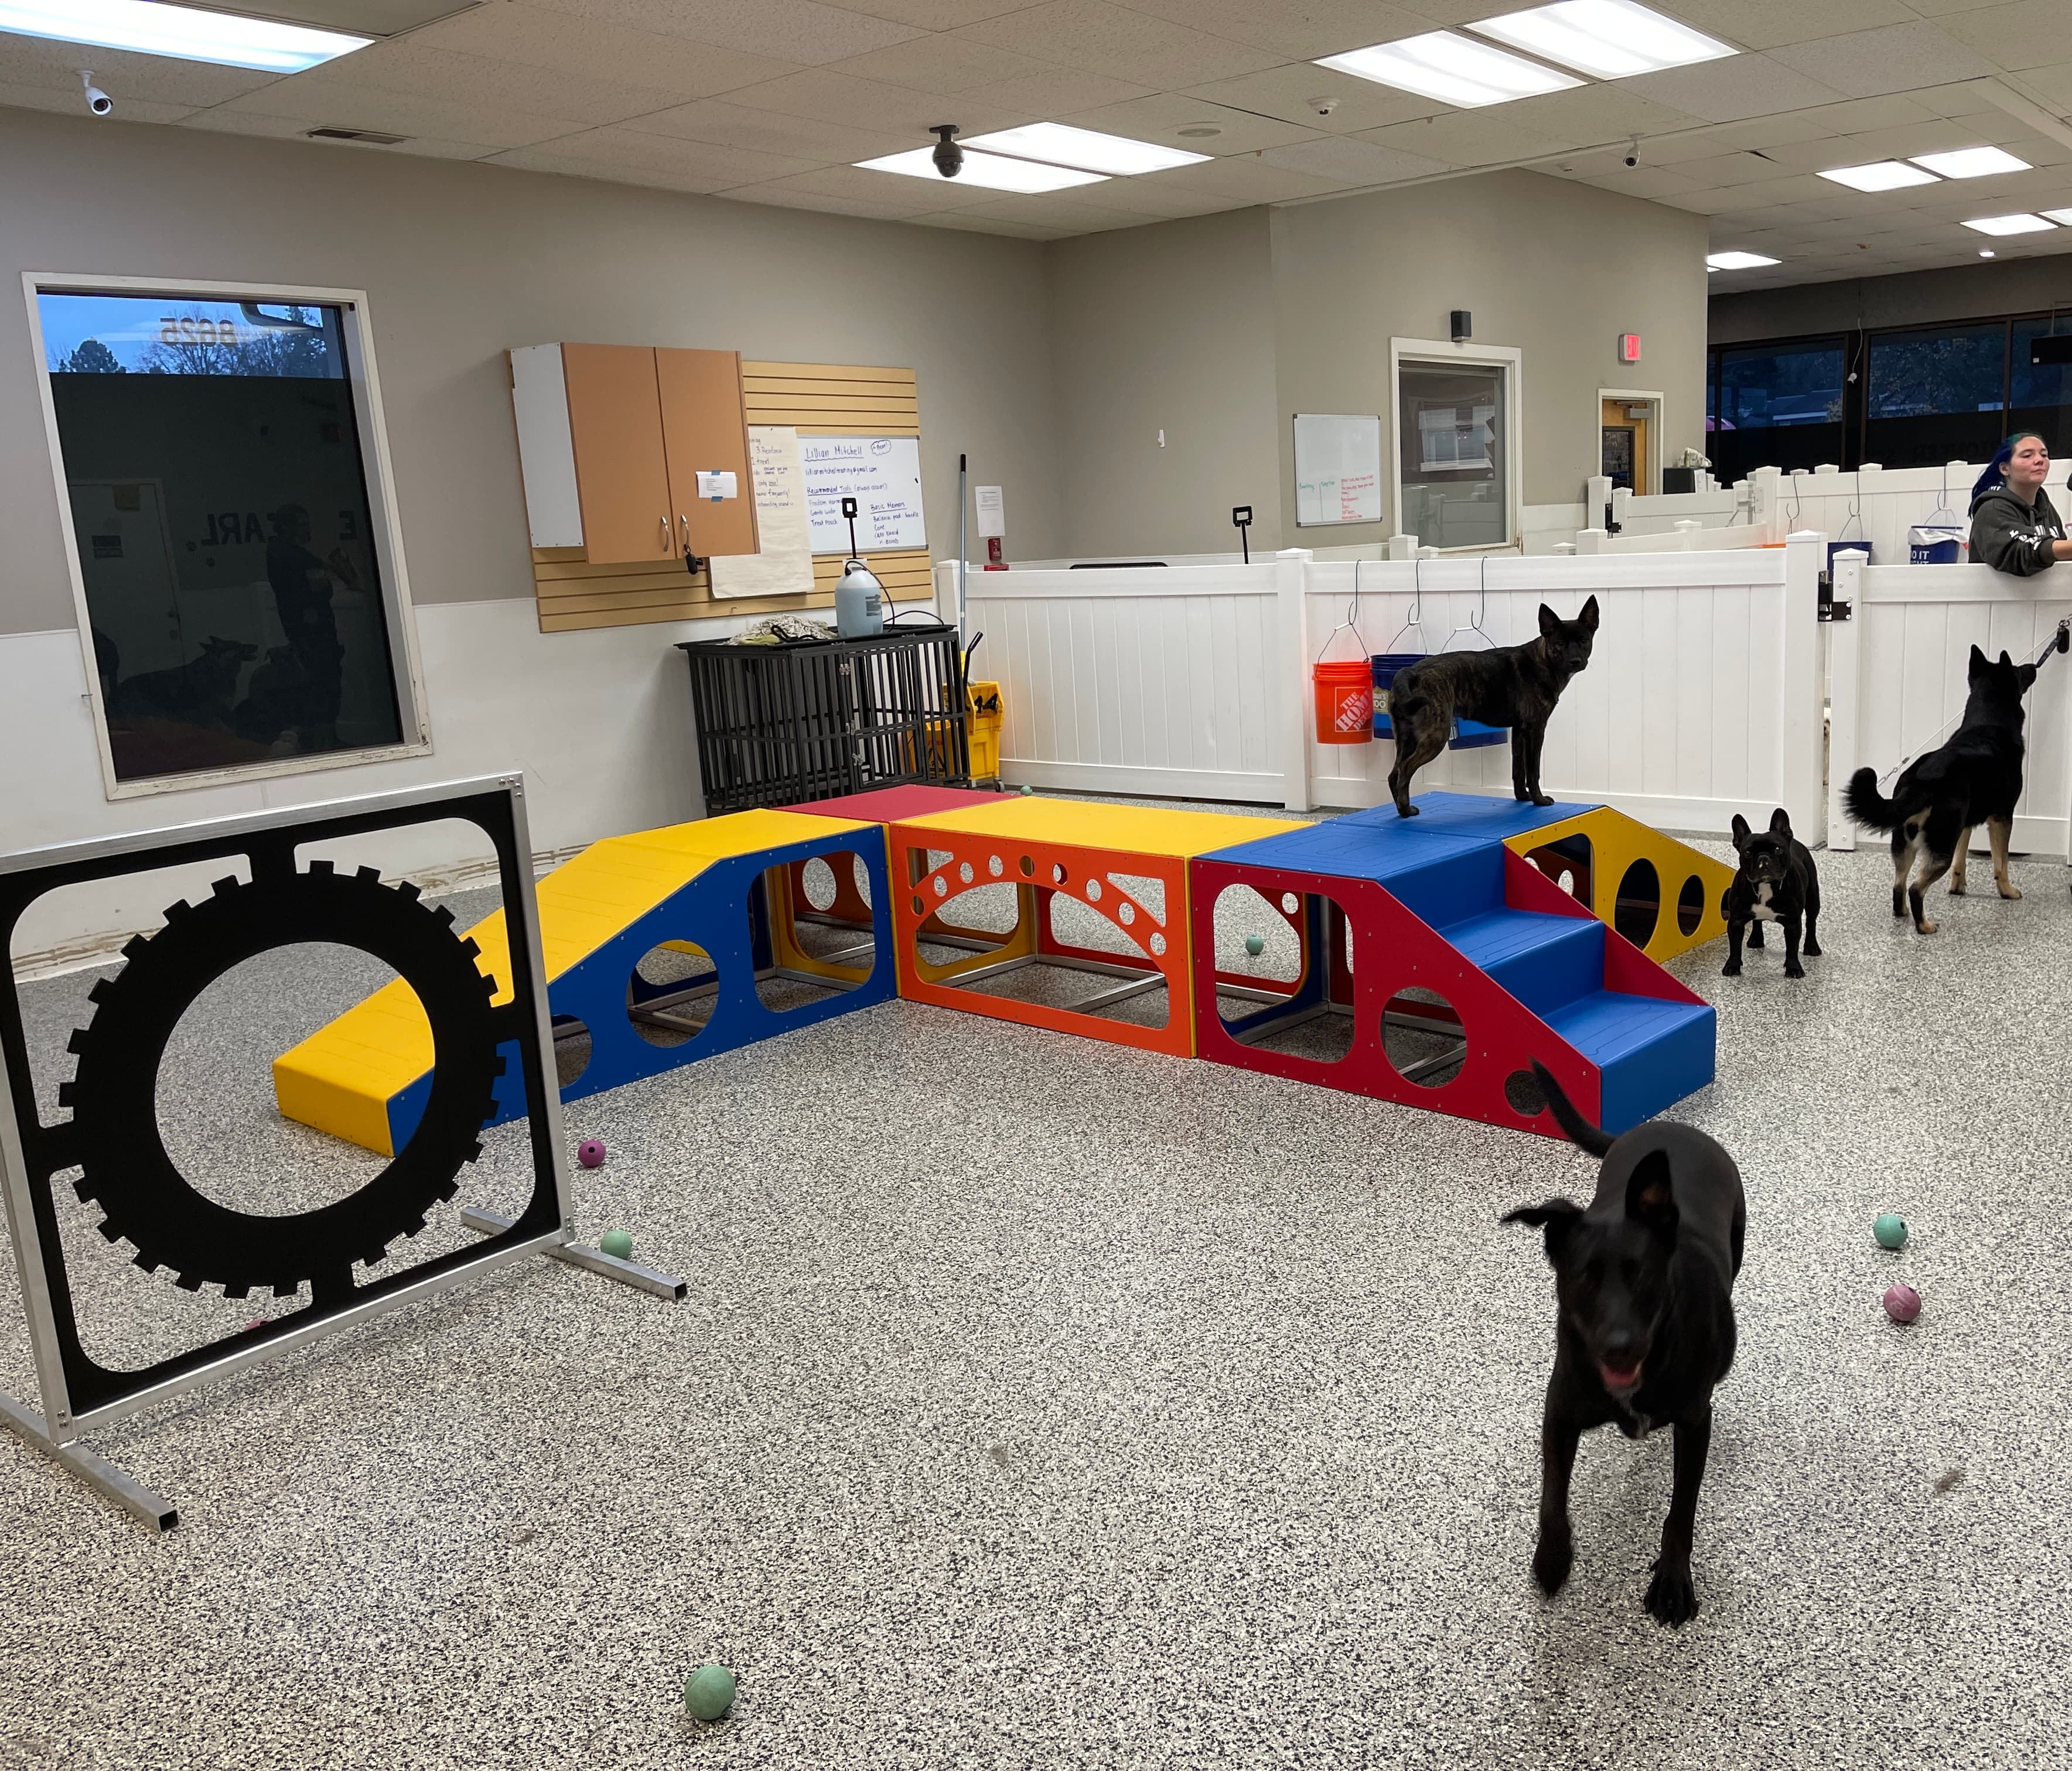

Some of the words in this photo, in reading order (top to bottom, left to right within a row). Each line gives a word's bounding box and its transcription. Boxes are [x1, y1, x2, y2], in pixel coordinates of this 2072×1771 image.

[806, 447, 830, 459] Lillian
[835, 445, 862, 456] Mitchell
[1919, 551, 1930, 560] IT
[1340, 691, 1360, 710] THE
